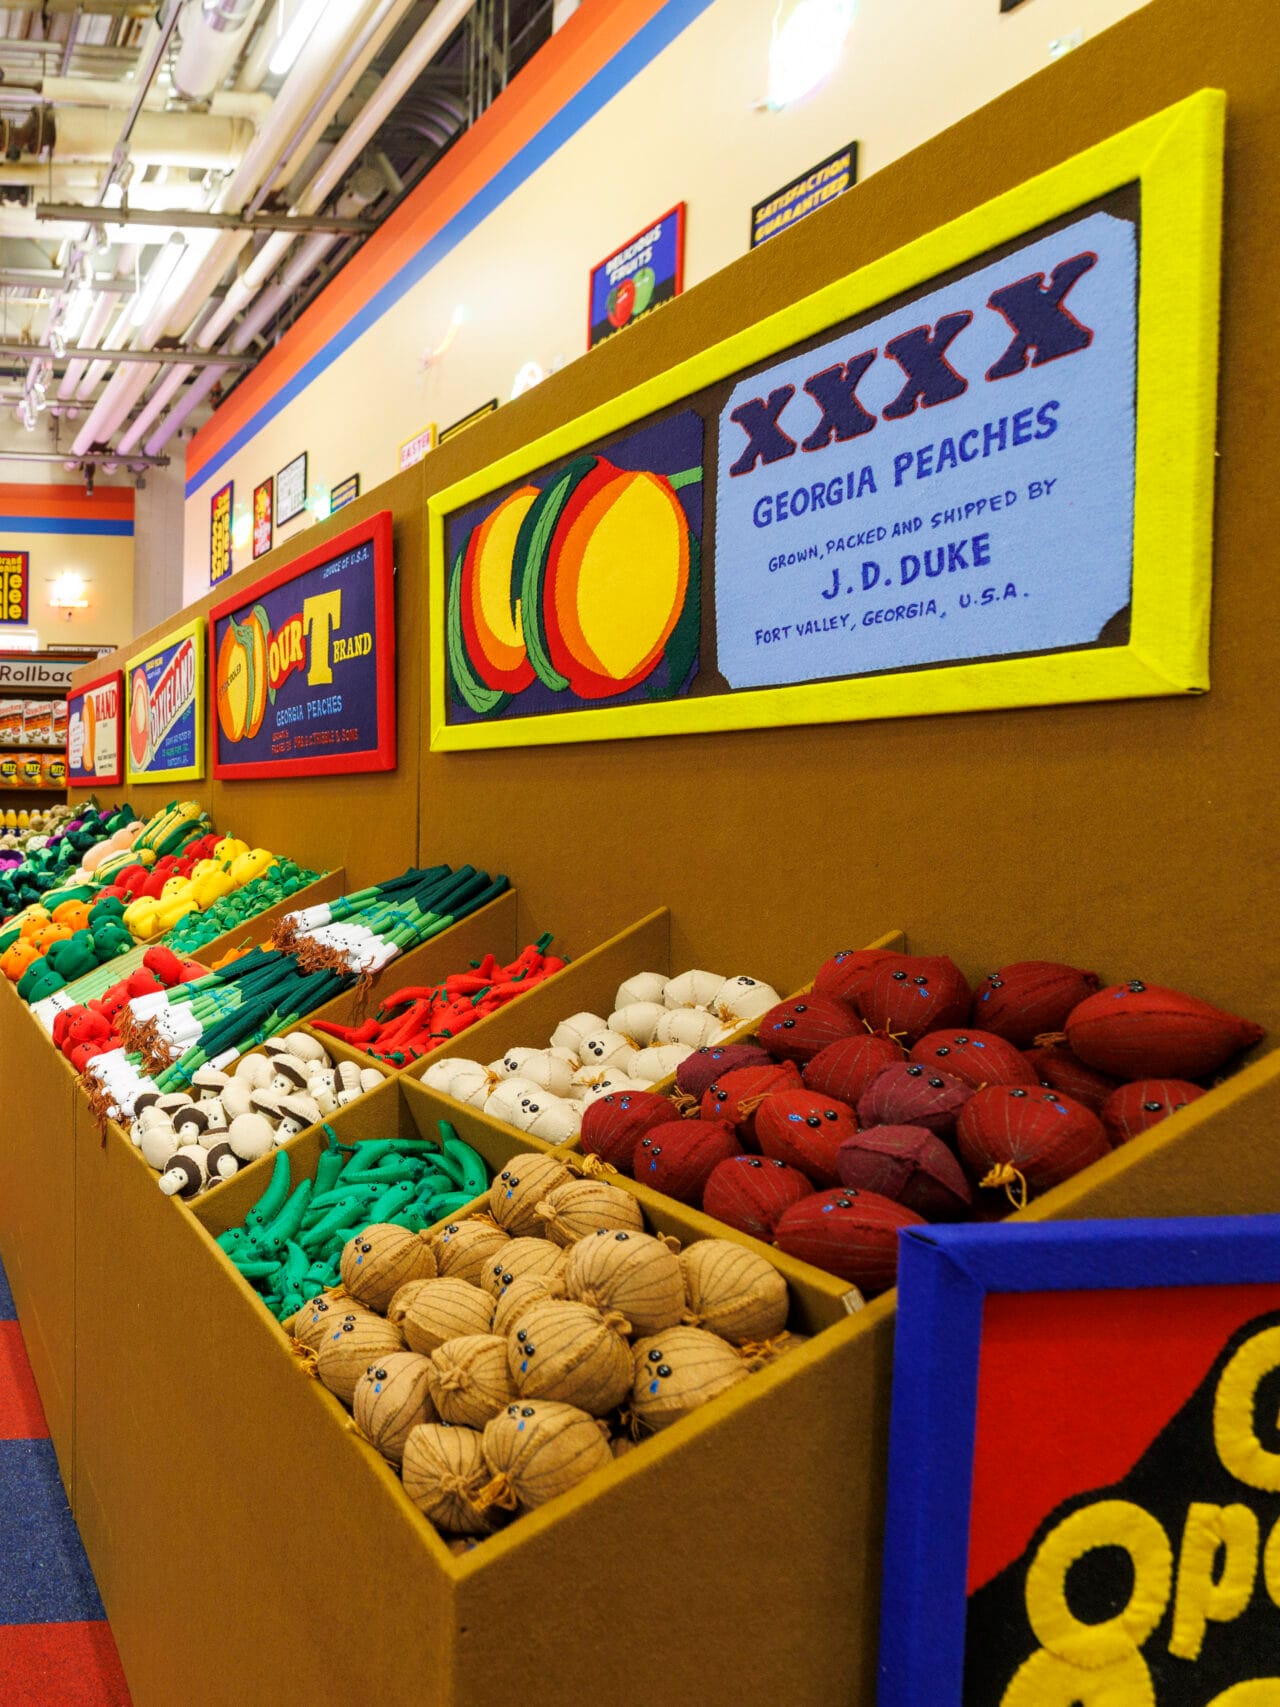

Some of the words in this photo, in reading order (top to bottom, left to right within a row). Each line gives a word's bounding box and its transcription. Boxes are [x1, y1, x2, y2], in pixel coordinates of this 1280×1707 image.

[754, 152, 851, 224] SATISFACTION
[754, 172, 850, 241] GUARANTEED
[729, 251, 1098, 478] XXXX
[752, 465, 877, 528] GEORGIA
[893, 400, 1060, 488] PEACHES
[826, 525, 887, 556] PACKED
[891, 515, 923, 538] AND
[931, 490, 1017, 530] SHIPPED
[1027, 477, 1058, 501] BY
[900, 532, 991, 586] DUKE
[269, 619, 303, 683] OUR
[302, 588, 342, 686] T
[332, 632, 373, 664] BRAND
[755, 625, 792, 646] FORT
[795, 612, 858, 639] VALLEY,
[862, 599, 947, 628] GEORGIA,
[959, 583, 1030, 609] U.S.A.
[0, 665, 72, 682] Rollbac
[276, 704, 304, 727] GEORGIA
[307, 695, 343, 720] PEACHES
